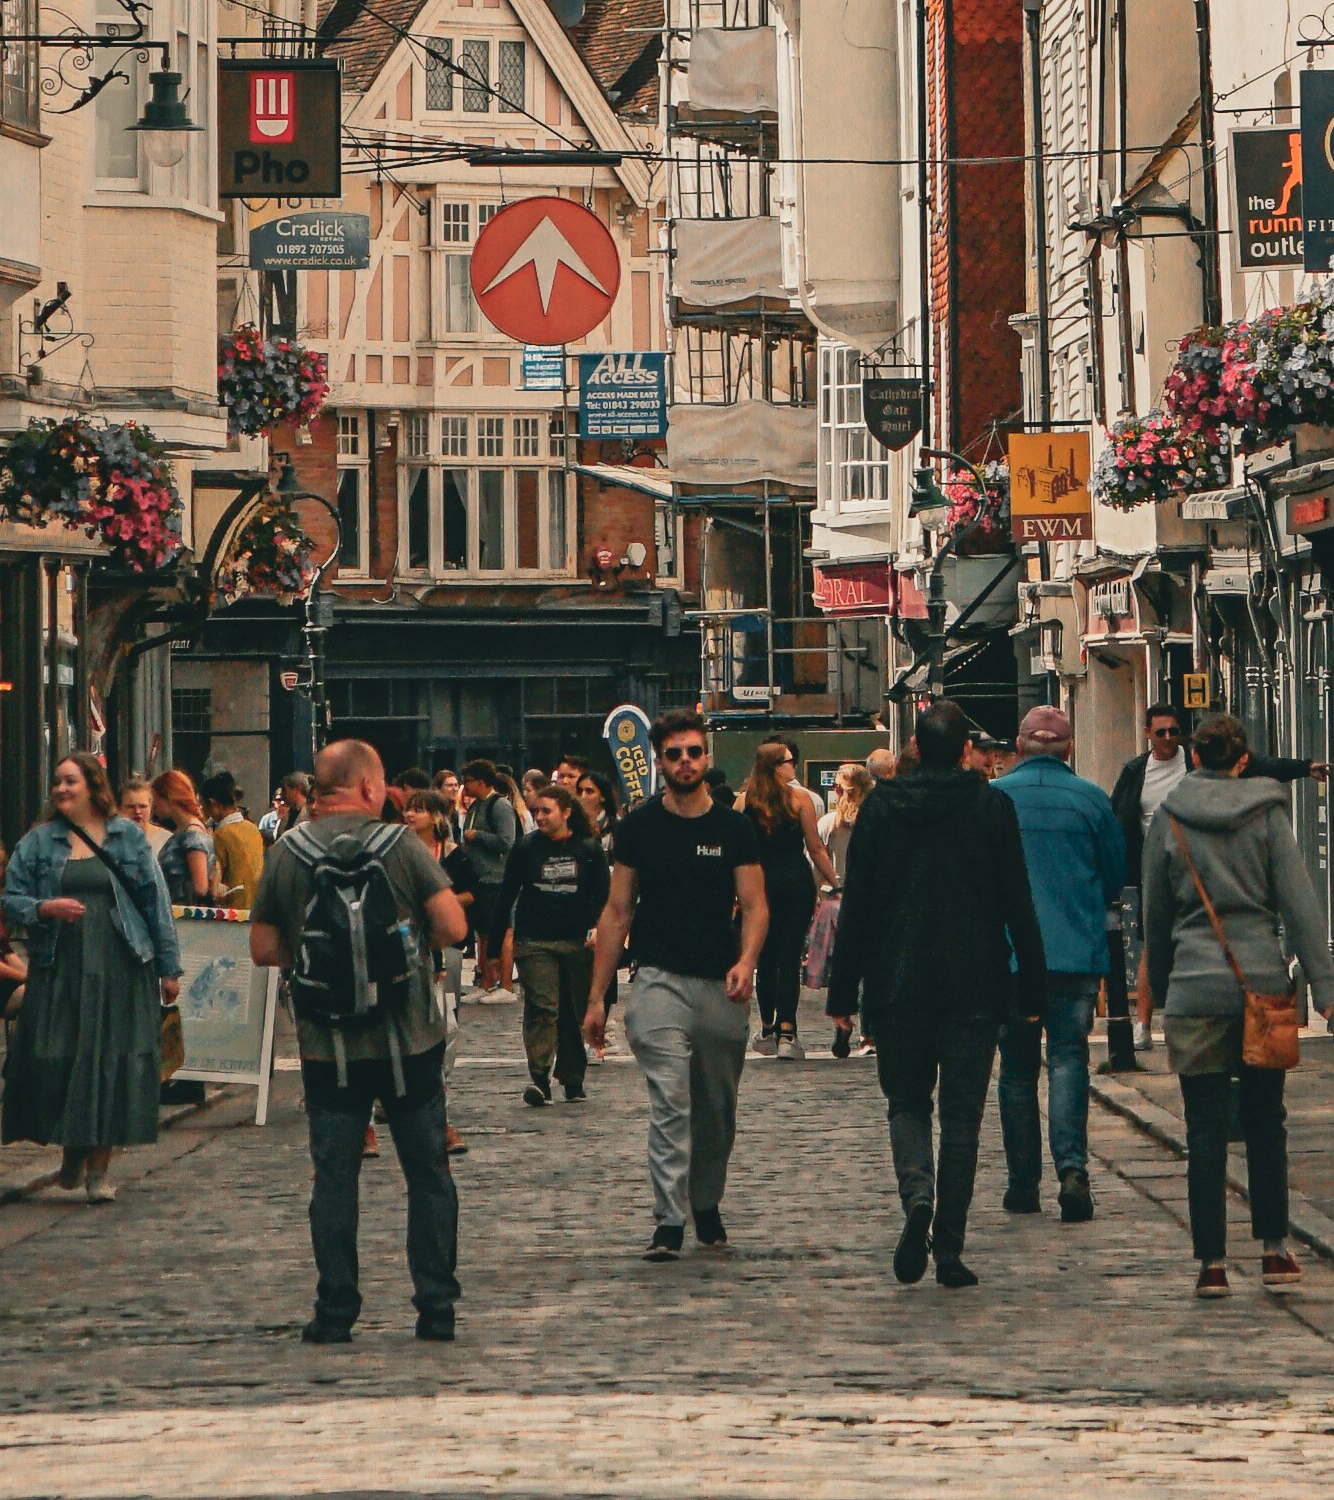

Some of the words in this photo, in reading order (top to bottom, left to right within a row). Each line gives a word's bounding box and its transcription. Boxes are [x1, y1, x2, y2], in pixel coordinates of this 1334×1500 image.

[234, 151, 310, 184] Pho
[1248, 196, 1276, 211] the
[276, 219, 345, 237] Cradick
[1250, 218, 1302, 234] runn
[277, 245, 307, 255] 01892
[309, 244, 345, 255] 707505
[1251, 236, 1304, 258] outle
[263, 256, 356, 266] www.cradick.co.uk
[594, 354, 648, 373] ALL
[587, 371, 659, 385] ACCESS
[617, 391, 639, 399] MADE
[640, 391, 659, 399] EASY
[603, 401, 628, 410] 01843
[1022, 518, 1083, 538] EWM
[631, 744, 648, 777] ICED
[616, 746, 644, 801] COFFE
[696, 844, 722, 857] Huel
